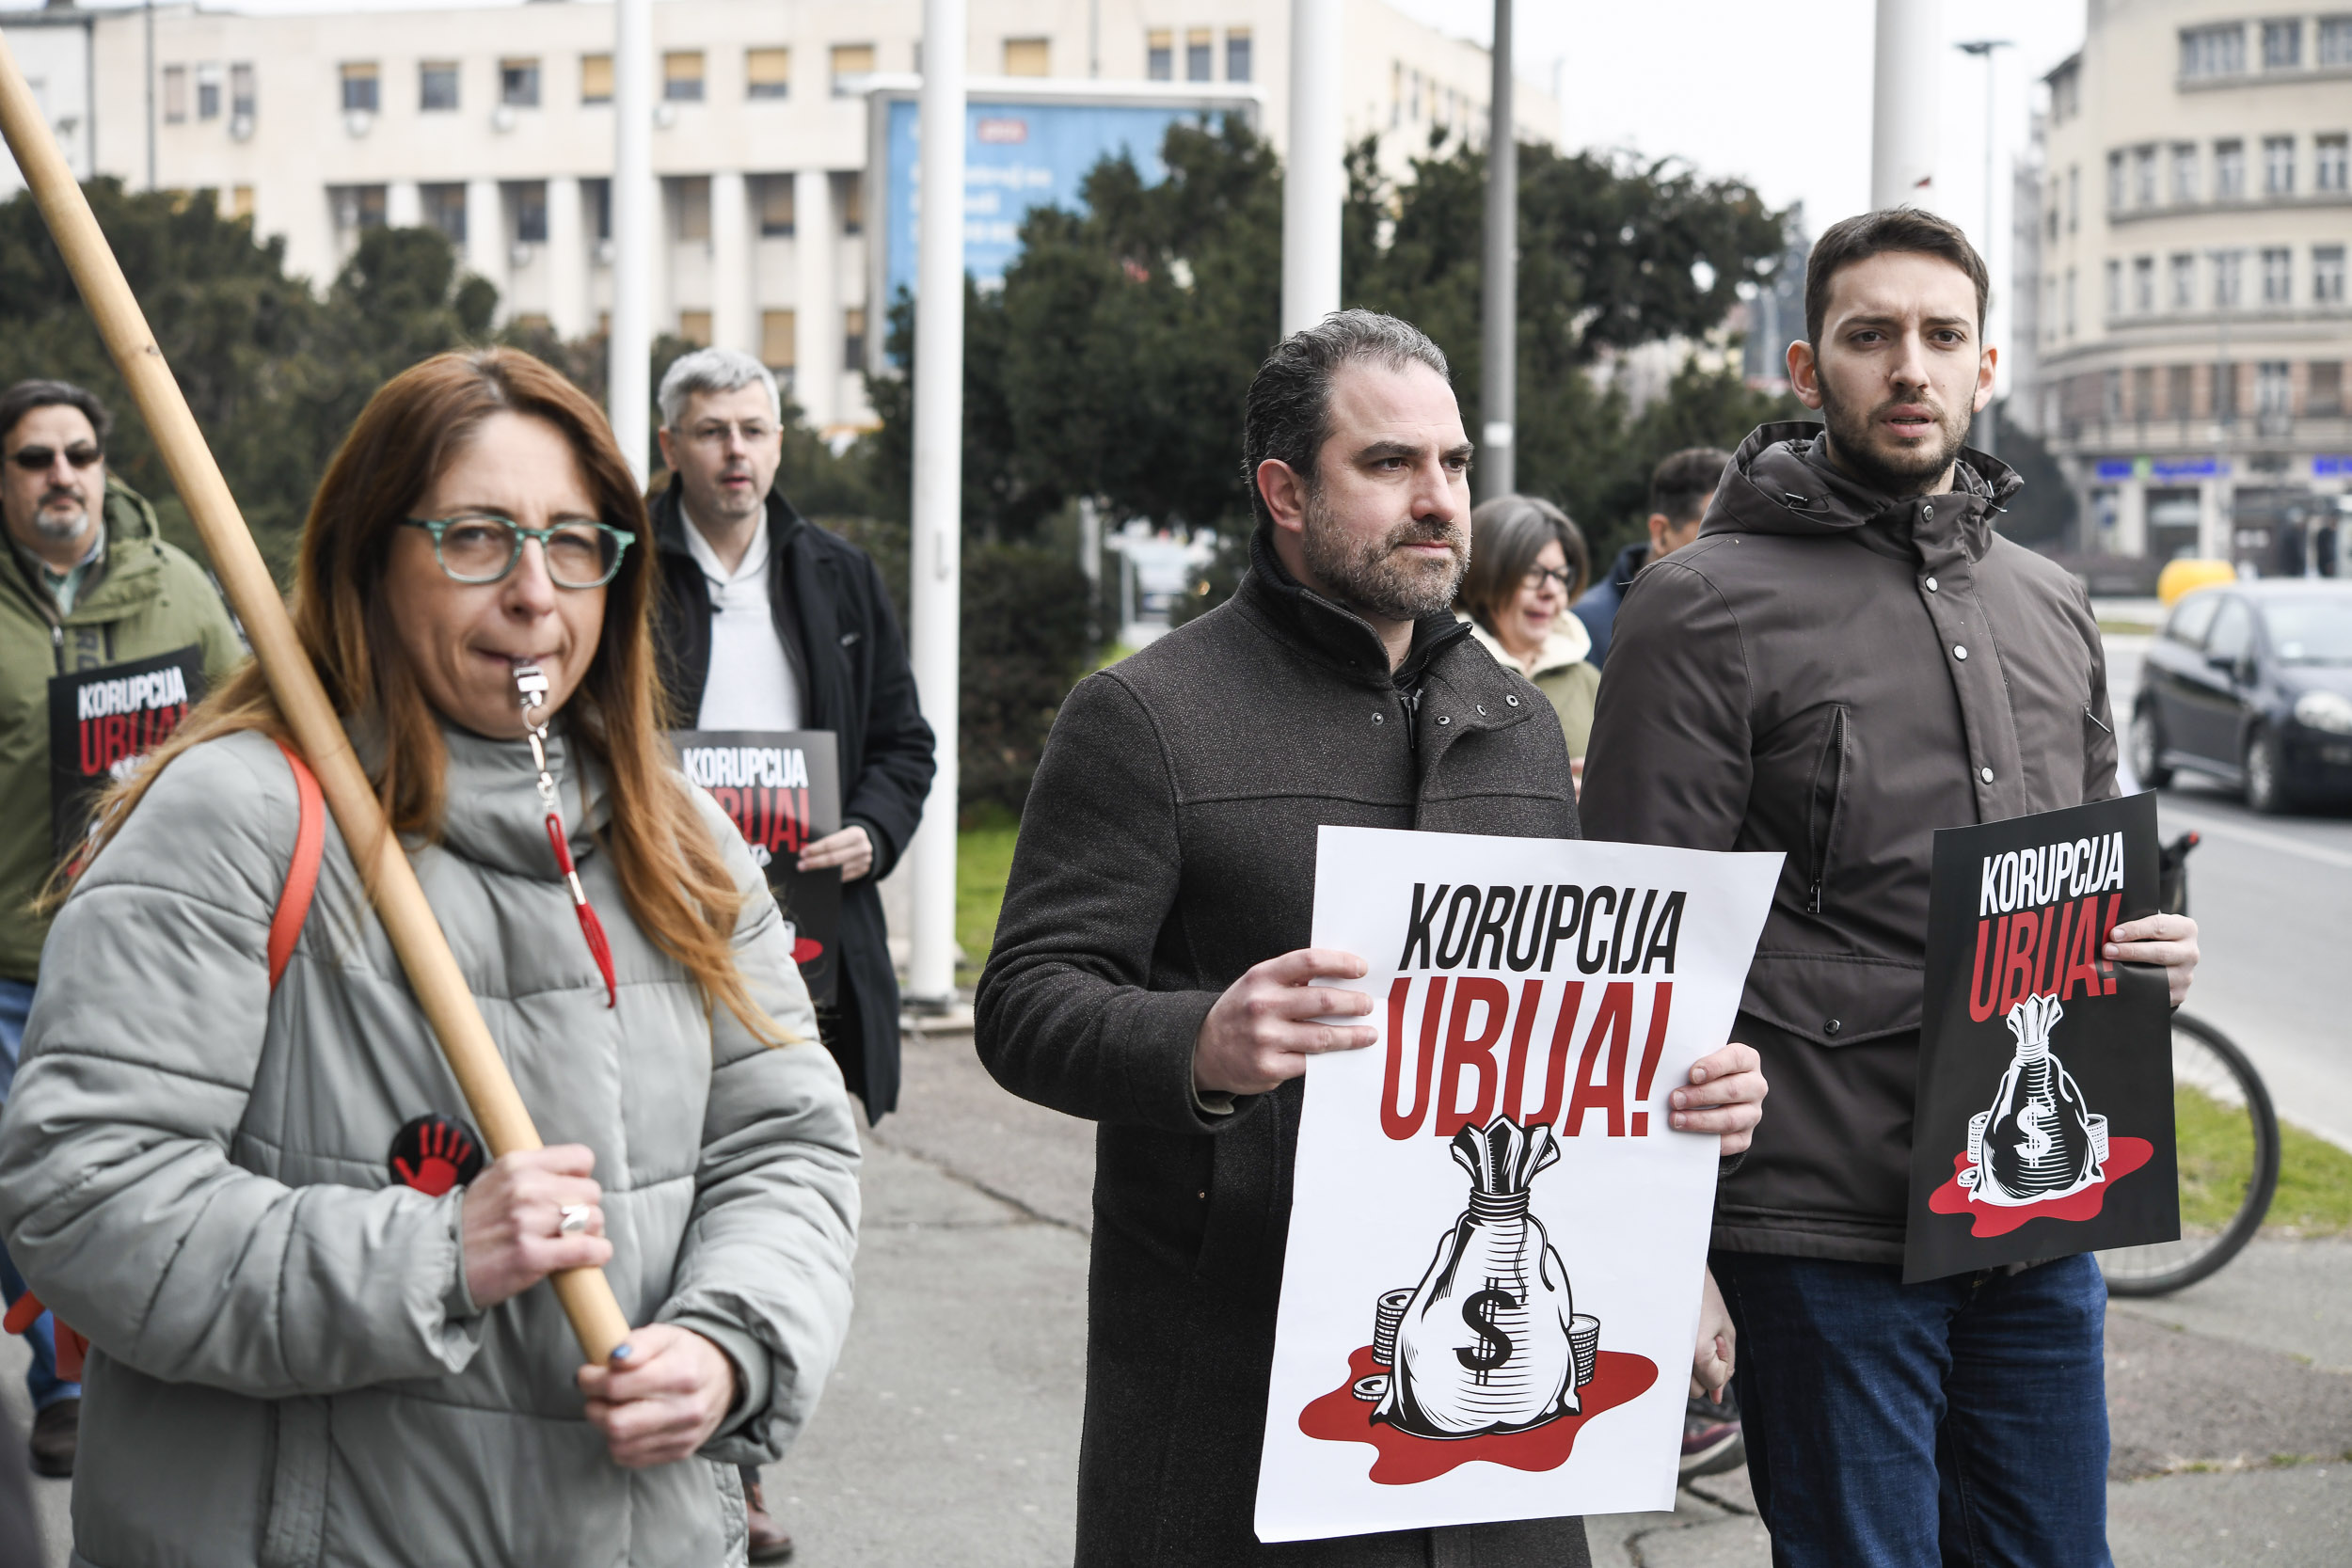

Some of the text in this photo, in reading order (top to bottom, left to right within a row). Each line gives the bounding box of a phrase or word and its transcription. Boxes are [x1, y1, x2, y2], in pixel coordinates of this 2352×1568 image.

[78, 666, 187, 721] KORUPCIJA
[683, 747, 808, 787] KORUPCIJA
[703, 787, 809, 852] IJA!
[1979, 832, 2123, 916] KORUPCIJA
[1398, 882, 1687, 974] KORUPCIJA
[1969, 894, 2122, 1022] UBIJA!
[1380, 976, 1673, 1141] UBIJA!
